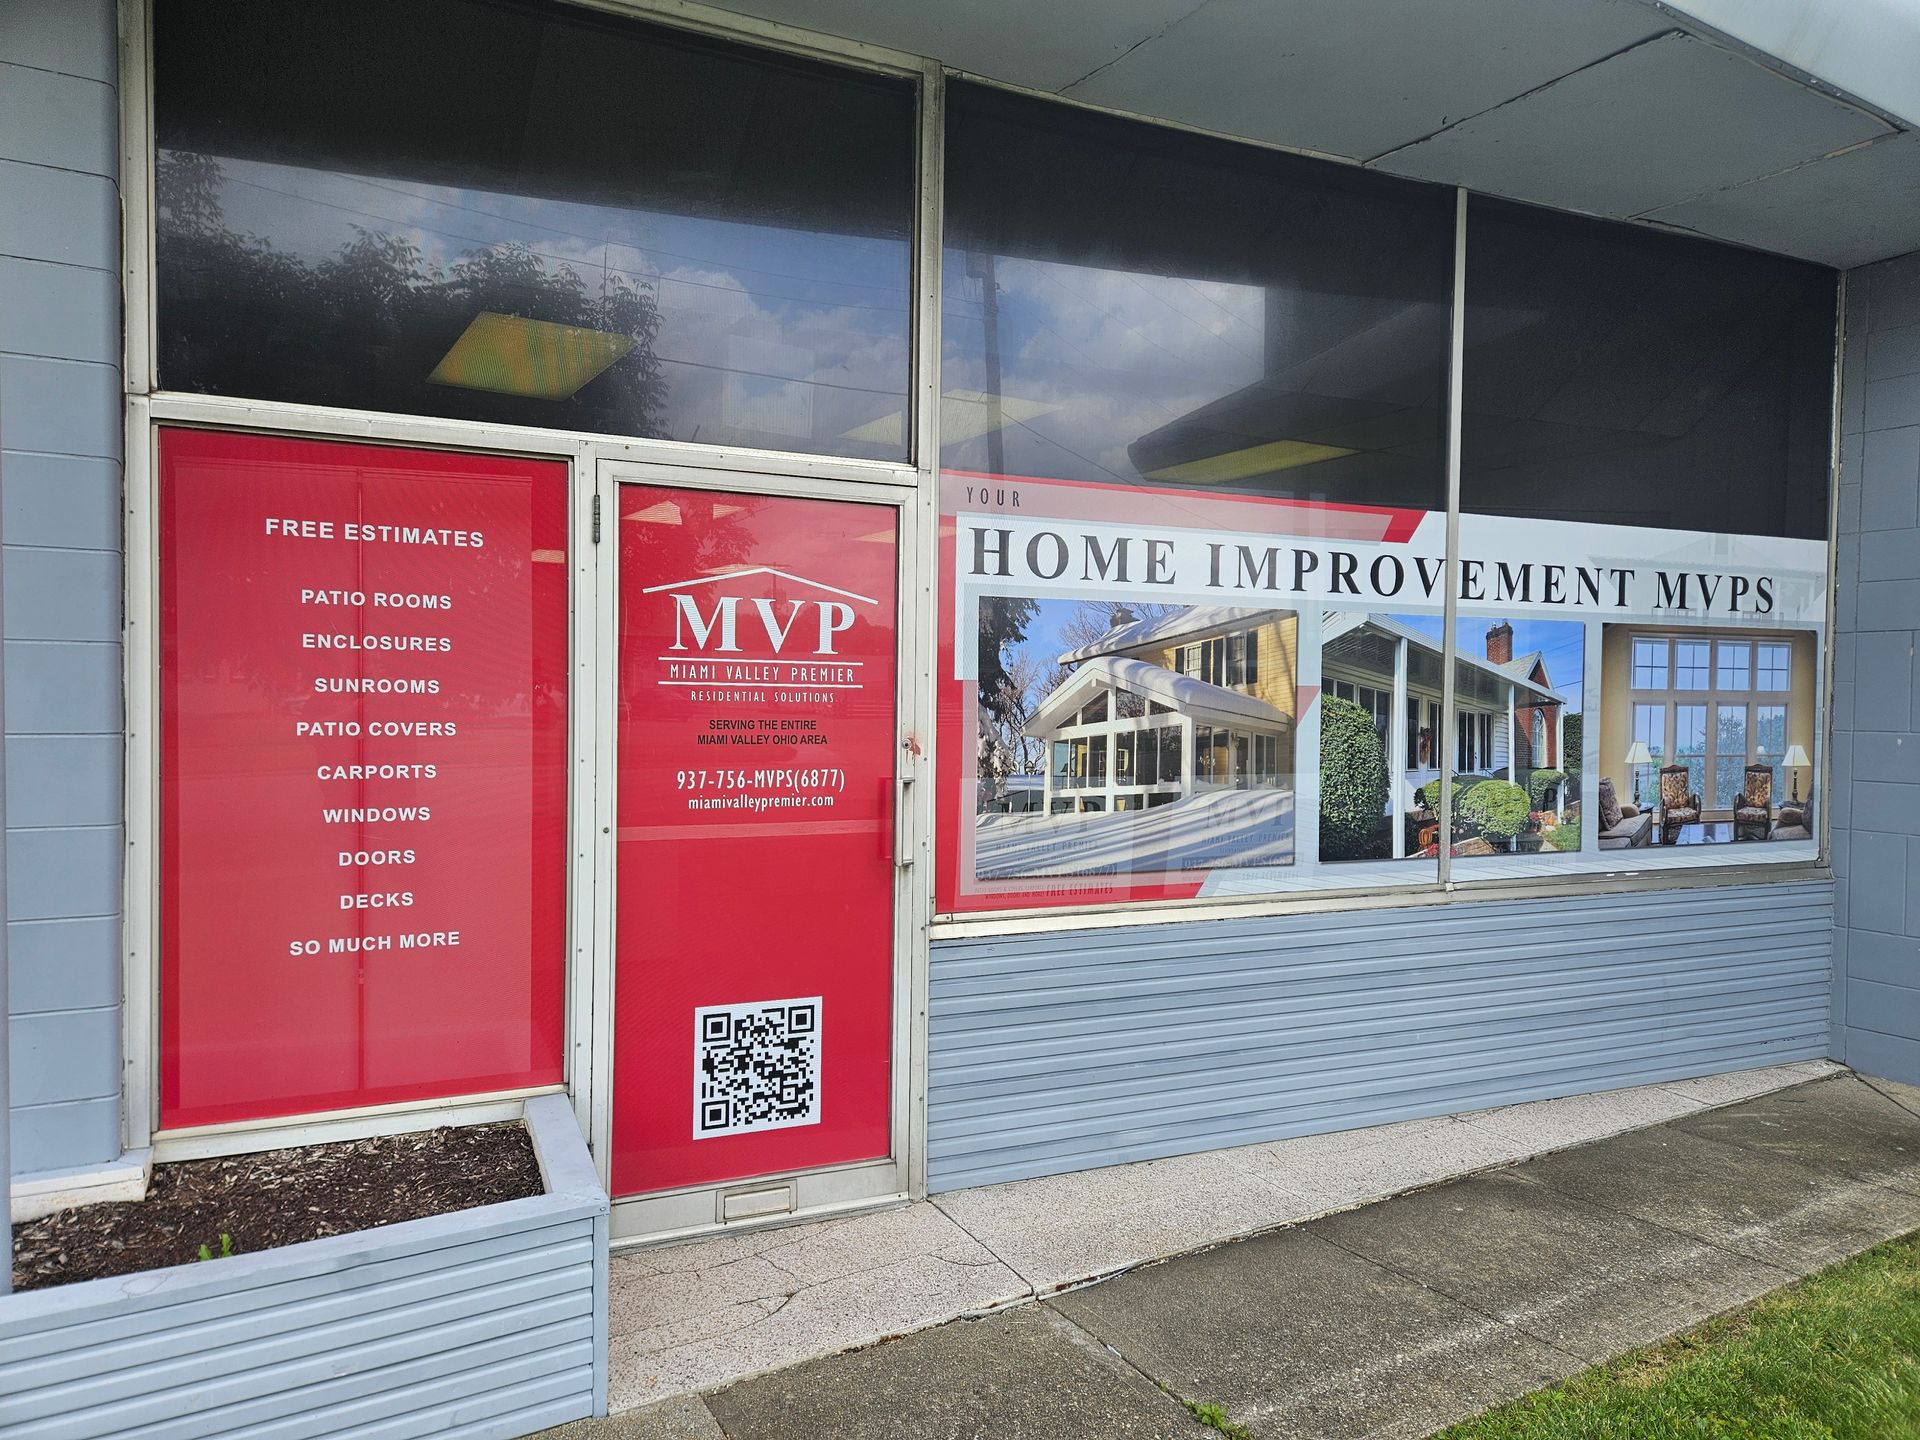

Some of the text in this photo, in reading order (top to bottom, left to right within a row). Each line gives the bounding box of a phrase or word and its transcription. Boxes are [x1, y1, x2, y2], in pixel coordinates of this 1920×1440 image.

[966, 486, 1020, 508] YOUR
[265, 518, 484, 548] FREE ESTIMATES
[967, 527, 1774, 614] HOME IMPROVEMENT MVPS
[301, 589, 452, 610] PATIO ROOMS
[668, 593, 856, 655] MVP
[302, 633, 451, 652] ENCLOSURES
[670, 664, 854, 682] MIAMI VALLEY PREMIER
[314, 677, 440, 694] SUNROOMS
[691, 690, 834, 703] RESIDENTIAL SOLUTIONS
[296, 721, 457, 737] PATIO COVERS
[709, 719, 817, 731] SERVING THE ENTIRE
[697, 734, 827, 745] MIAMI VALLEY OHIO AREA
[317, 764, 437, 780] CARPORTS
[676, 768, 845, 792] 937-756-MVPS(6877)
[688, 794, 834, 812] miamivalleypremier.com
[322, 806, 431, 824] WINDOWS
[338, 849, 416, 867] DOORS
[340, 891, 414, 910] DECKS
[289, 931, 460, 956] SO MUCH MORE
